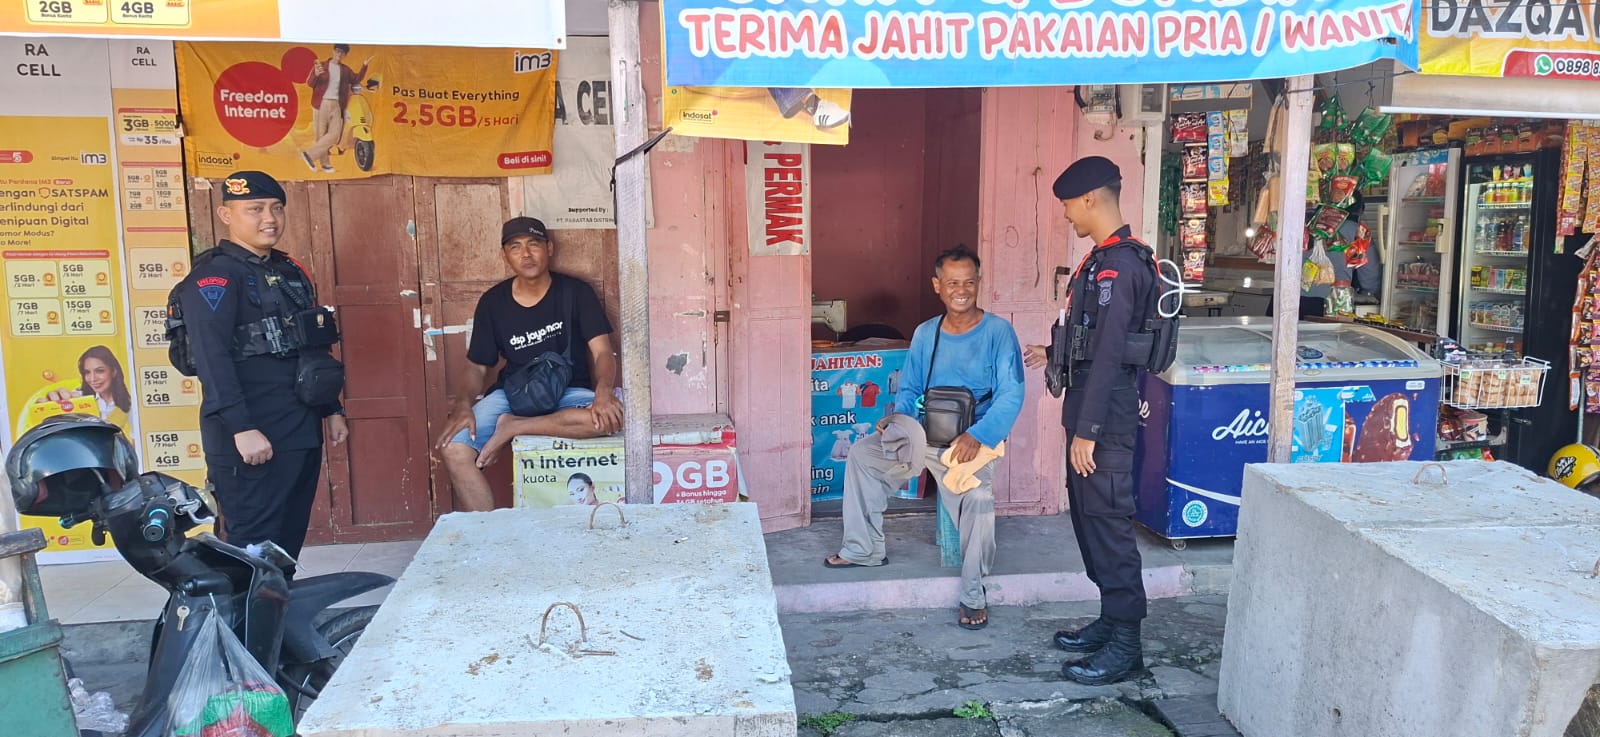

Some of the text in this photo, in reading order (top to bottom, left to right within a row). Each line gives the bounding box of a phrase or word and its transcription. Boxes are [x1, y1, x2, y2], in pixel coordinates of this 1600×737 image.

[40, 1, 72, 14] 2GB
[121, 2, 154, 14] 4GB
[685, 14, 844, 53] TERIMA
[858, 16, 970, 55] JAHIT
[982, 17, 1145, 54] PAKAIAN
[1157, 16, 1243, 51] PRIA
[24, 43, 49, 57] RA
[136, 46, 150, 55] RA
[131, 58, 157, 66] CELL
[515, 52, 551, 72] im3
[1556, 60, 1590, 73] 0898
[17, 63, 61, 76] CELL
[220, 89, 289, 103] Freedom
[393, 86, 520, 103] Pas Buat Everything
[225, 105, 286, 118] Internet
[393, 102, 477, 127] 2,5GB
[493, 114, 519, 126] Hari
[682, 110, 712, 120] indosat
[123, 119, 149, 131] 3GB
[144, 136, 159, 145] 35
[81, 152, 107, 164] im3
[199, 153, 233, 165] indosat
[504, 154, 547, 165] Beli di sini!
[51, 189, 109, 197] SATSPAM
[764, 153, 804, 246] PERMAK
[60, 202, 84, 211] dari
[50, 216, 89, 227] Digital
[139, 264, 163, 272] 5GB
[65, 285, 86, 293] 2GB
[143, 310, 167, 319] 7GB
[71, 321, 93, 329] 4GB
[144, 371, 168, 379] 5GB
[146, 394, 170, 402] 2GB
[820, 412, 856, 425] anak
[1211, 408, 1269, 440] Aic
[149, 434, 179, 442] 15GB
[155, 456, 180, 464] 4GB
[540, 453, 618, 469] Internet
[523, 473, 557, 484] kuota
[702, 489, 727, 498] hingga
